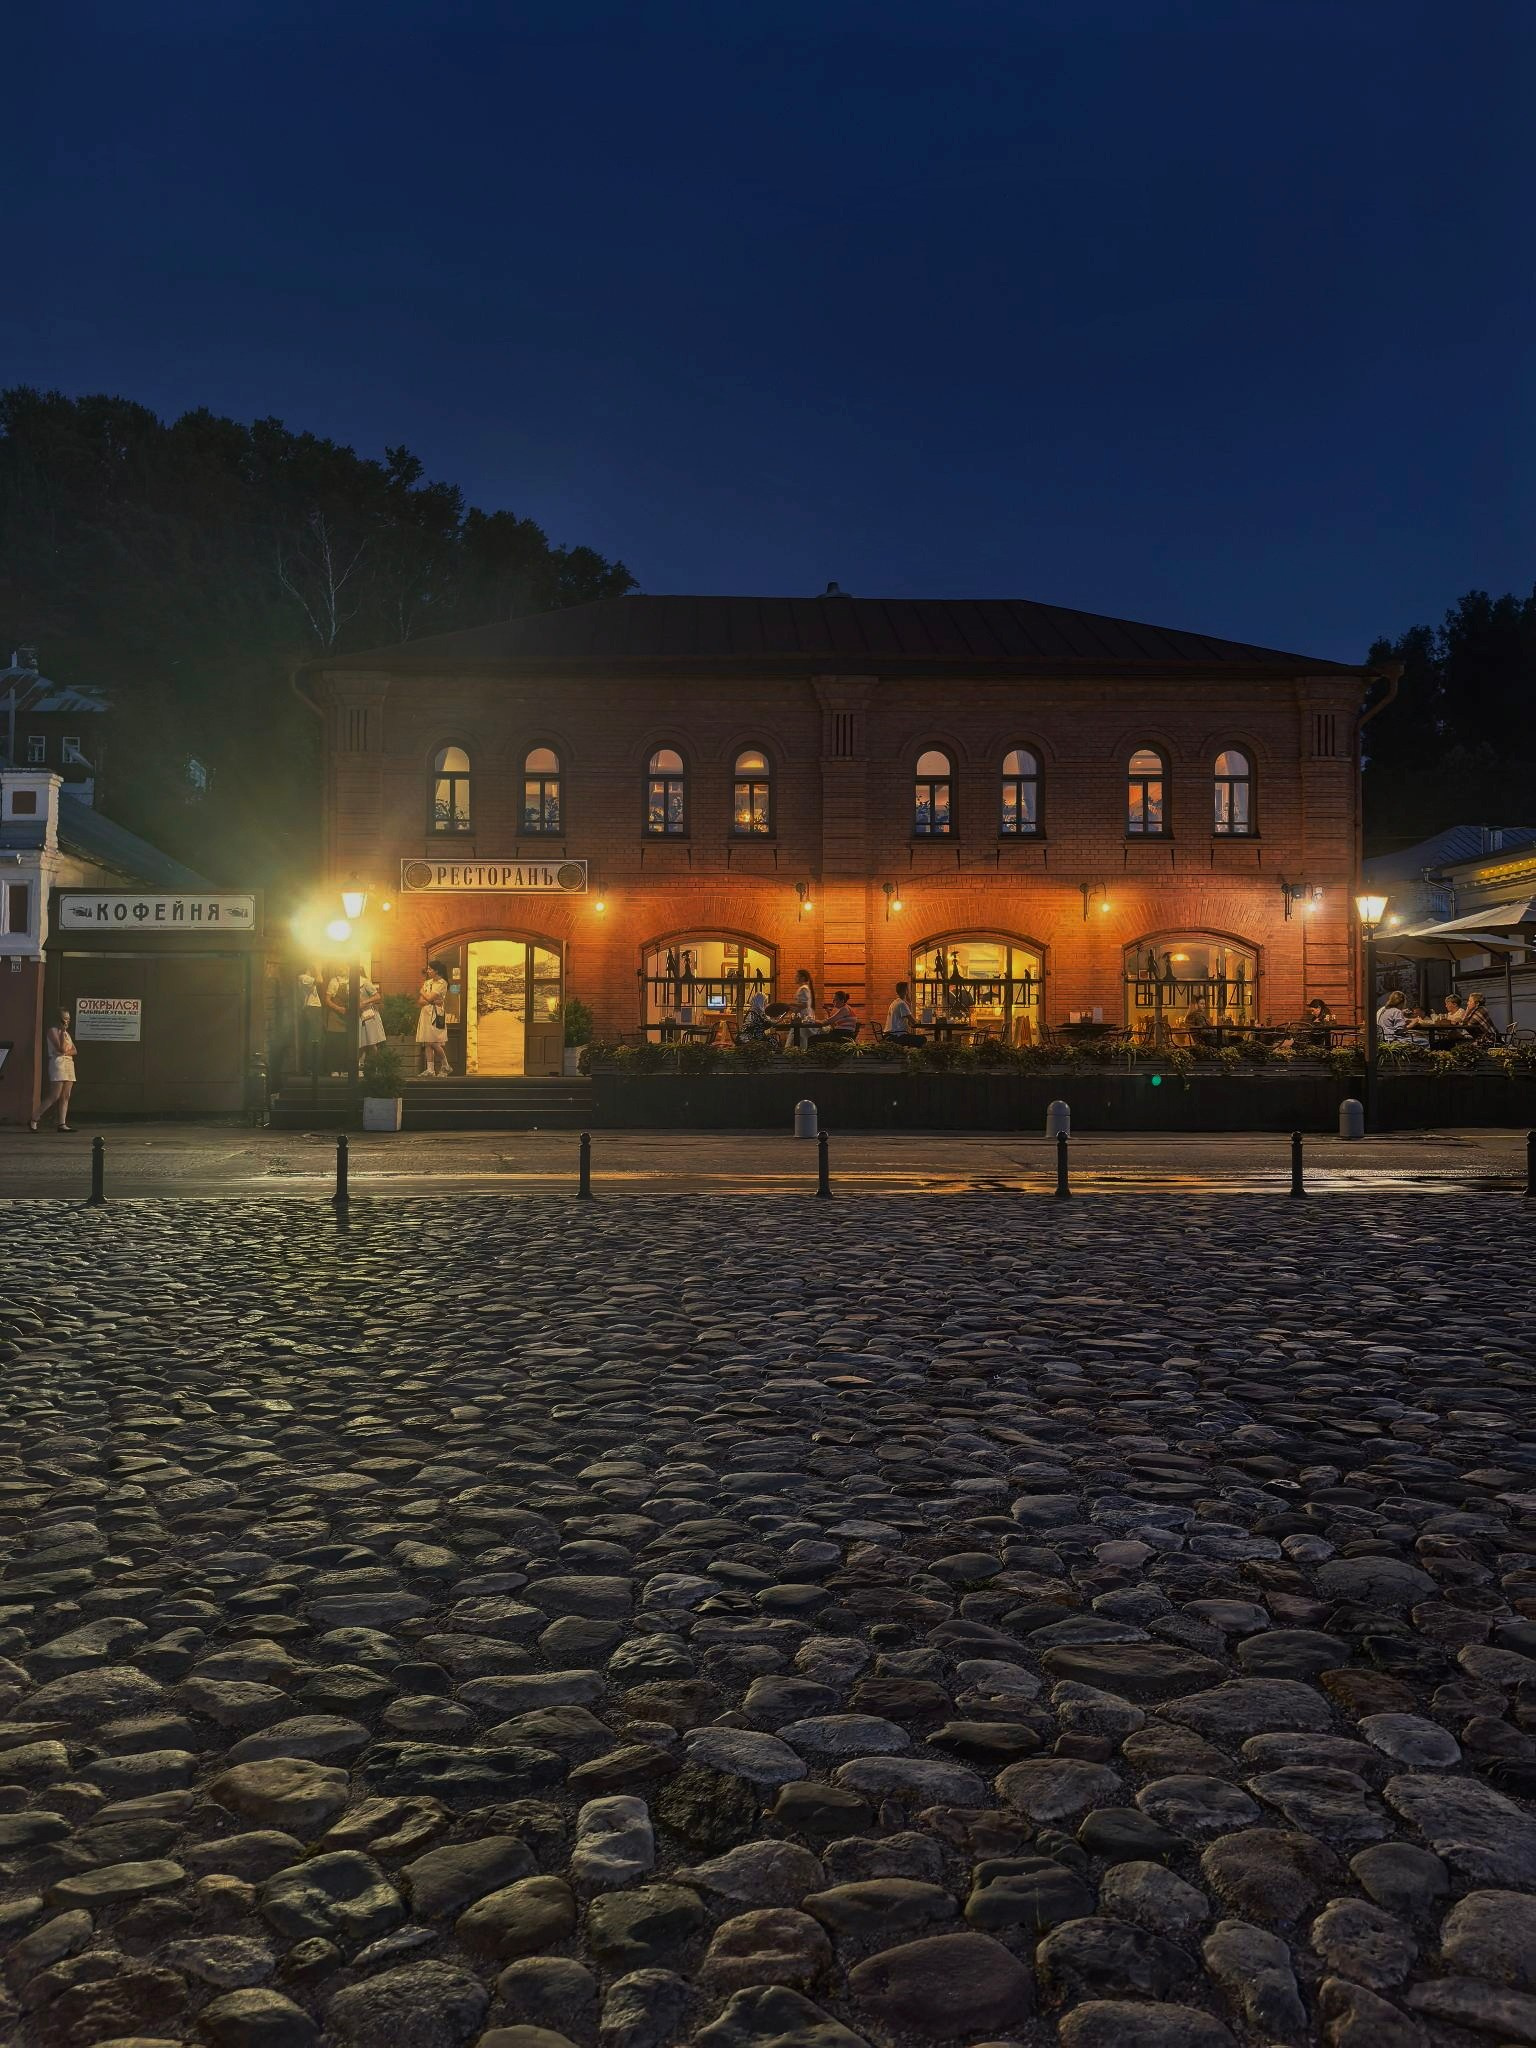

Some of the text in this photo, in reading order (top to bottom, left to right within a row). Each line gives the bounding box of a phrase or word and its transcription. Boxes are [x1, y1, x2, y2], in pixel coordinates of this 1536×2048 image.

[437, 866, 553, 886] РЕСТОРАНЪ
[97, 900, 220, 921] КОФЕЙНЯ
[79, 1000, 138, 1010] ОТКРЫЛСЯ
